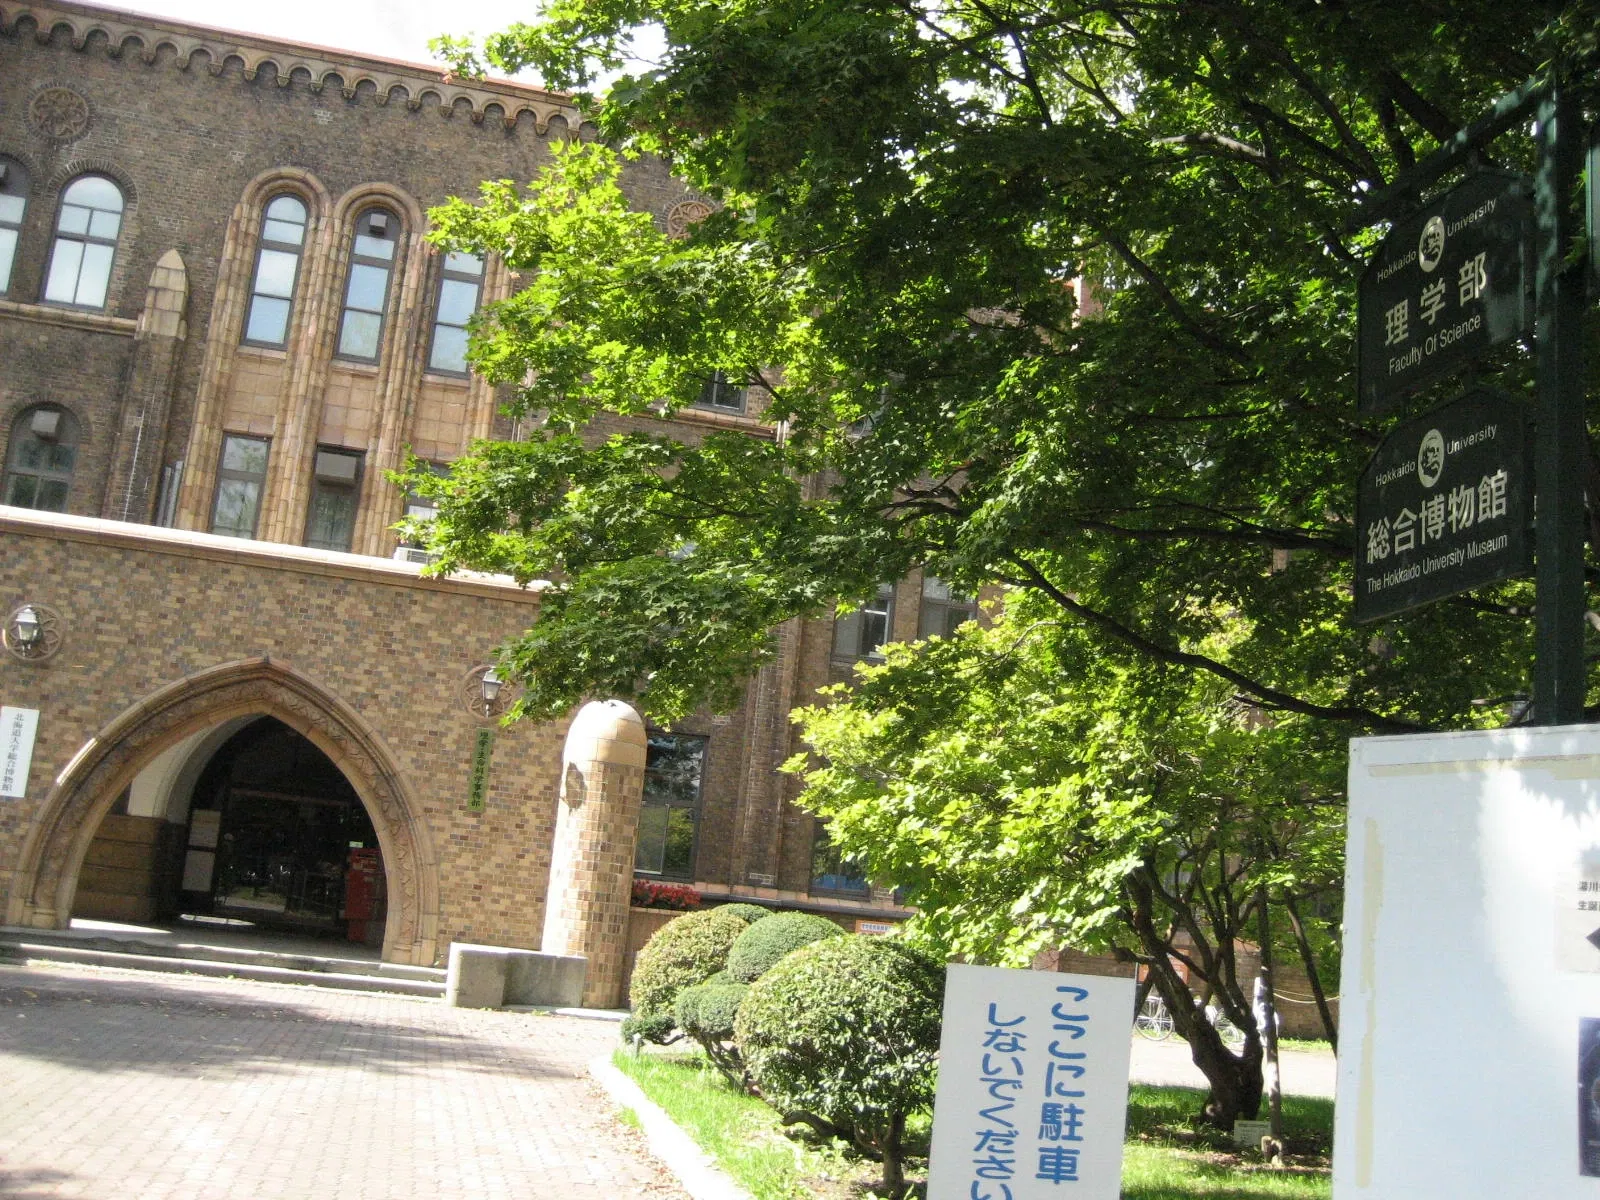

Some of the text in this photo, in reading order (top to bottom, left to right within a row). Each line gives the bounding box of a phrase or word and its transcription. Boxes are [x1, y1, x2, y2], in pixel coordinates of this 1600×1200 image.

[1377, 198, 1497, 283] Hokkaido University
[1384, 251, 1487, 346] 理学部
[1389, 314, 1481, 376] Faculty Of Science
[1375, 424, 1498, 488] Hokkaido University
[1367, 468, 1508, 565] 総合博物館
[1367, 534, 1508, 594] The Hokkaido University Museum
[1578, 900, 1600, 911] 生誕
[970, 1002, 1027, 1200] しないでください
[1035, 985, 1090, 1185] ここに駐車
